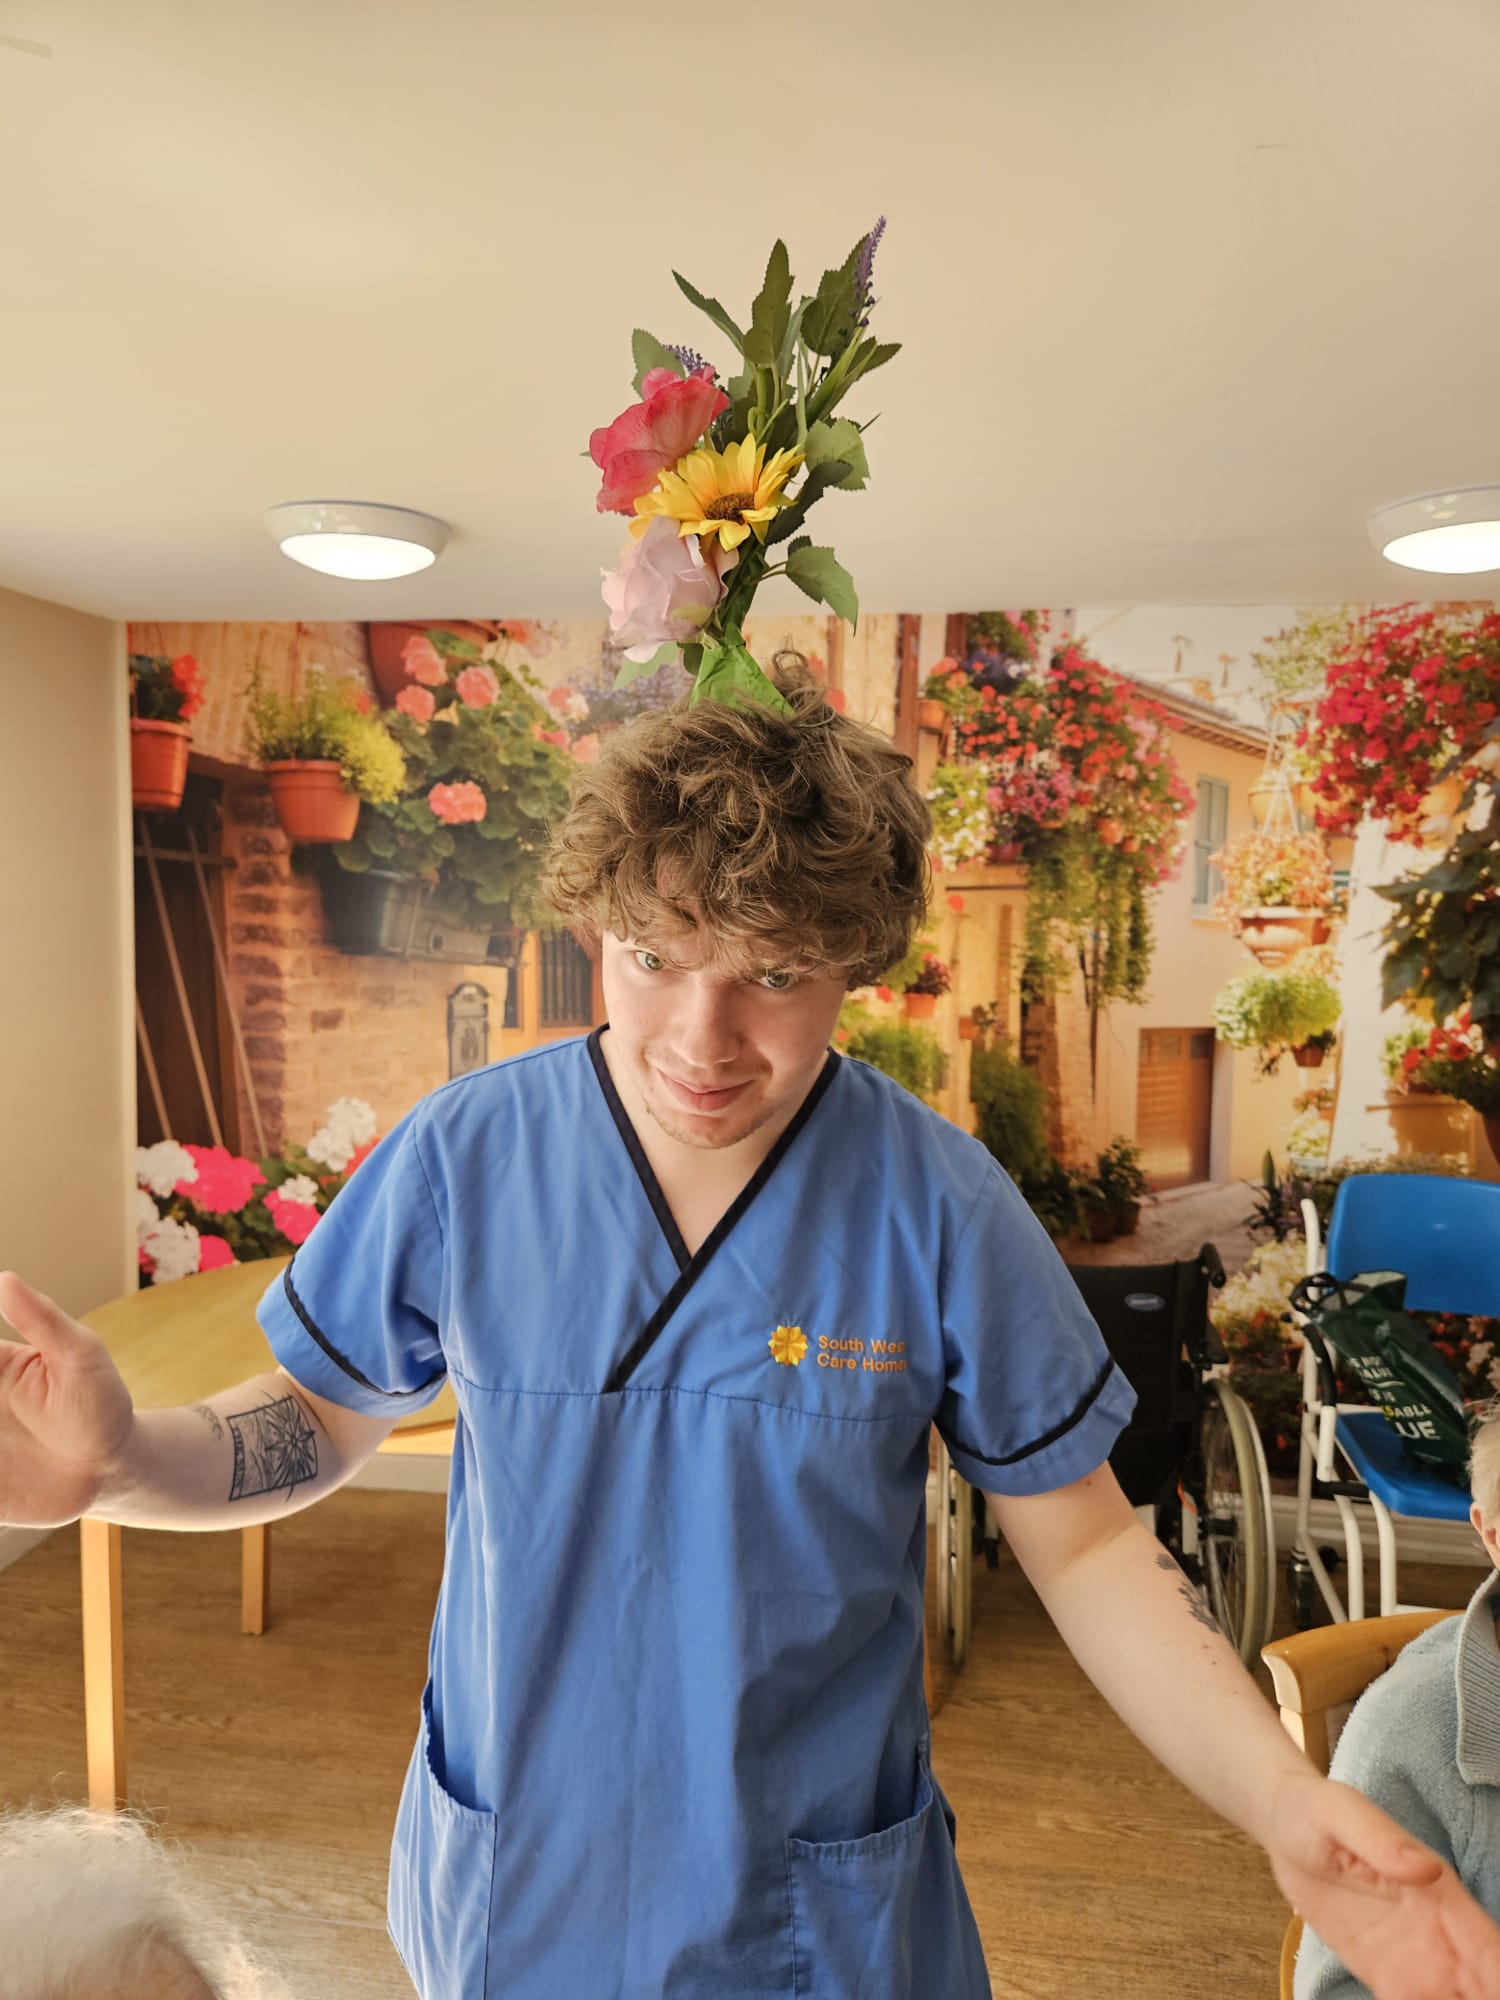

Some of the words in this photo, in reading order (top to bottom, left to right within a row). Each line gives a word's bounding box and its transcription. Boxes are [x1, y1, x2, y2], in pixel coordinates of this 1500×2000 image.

[818, 1335, 865, 1352] South
[871, 1339, 907, 1354] Wes
[817, 1353, 857, 1370] Care
[1395, 1420, 1440, 1440] UE
